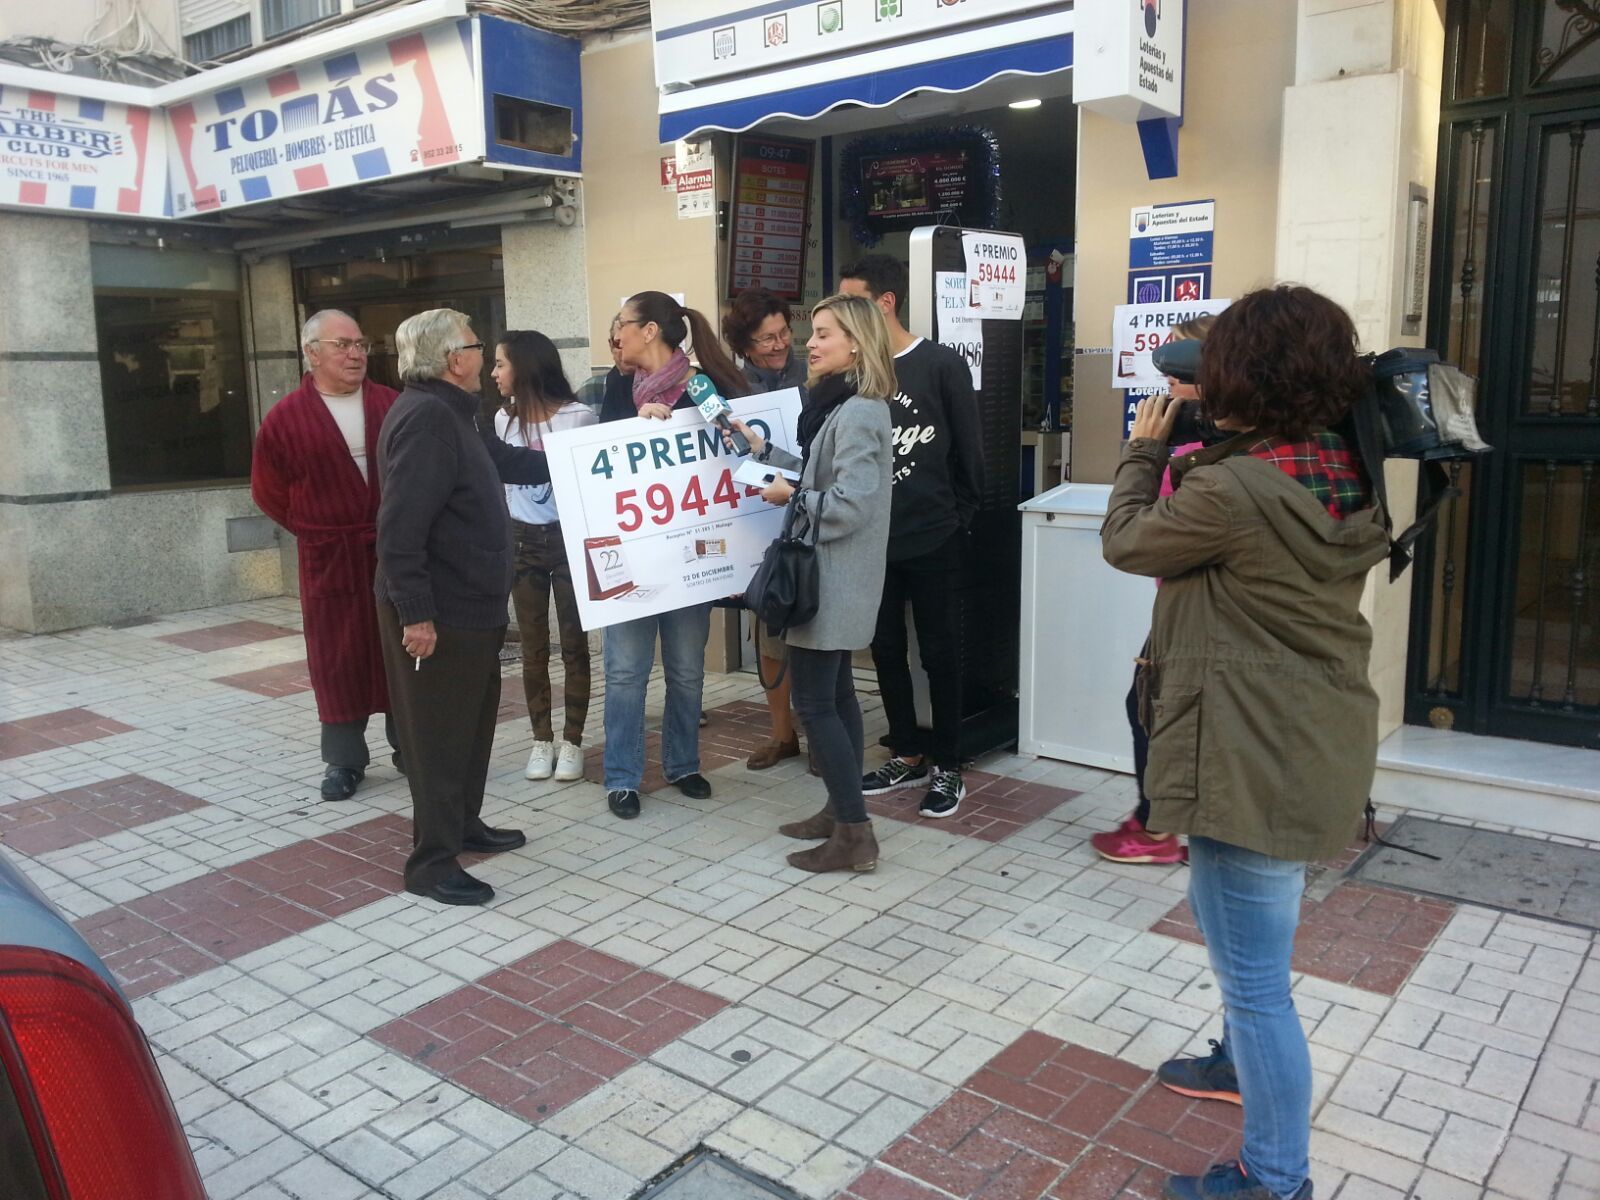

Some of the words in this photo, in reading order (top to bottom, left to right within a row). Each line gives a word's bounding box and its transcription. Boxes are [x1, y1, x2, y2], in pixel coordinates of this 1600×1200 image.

[1140, 56, 1165, 79] Apuestas
[1139, 73, 1158, 93] Estado
[16, 108, 56, 123] THE
[7, 140, 71, 158] CLUB
[284, 135, 326, 162] HOMBRES
[2, 155, 42, 169] RCUTS
[46, 160, 69, 170] FOR
[72, 163, 99, 174] MEN
[7, 167, 45, 180] SINCE
[679, 174, 711, 186] Alarma
[1152, 218, 1178, 226] Apuestas
[982, 244, 1018, 260] PREMIO
[978, 263, 1016, 283] 59444
[626, 419, 771, 474] PREMO
[892, 424, 936, 456] age
[600, 550, 623, 572] 22
[692, 572, 700, 580] DE
[701, 565, 734, 577] DICIEMBRE
